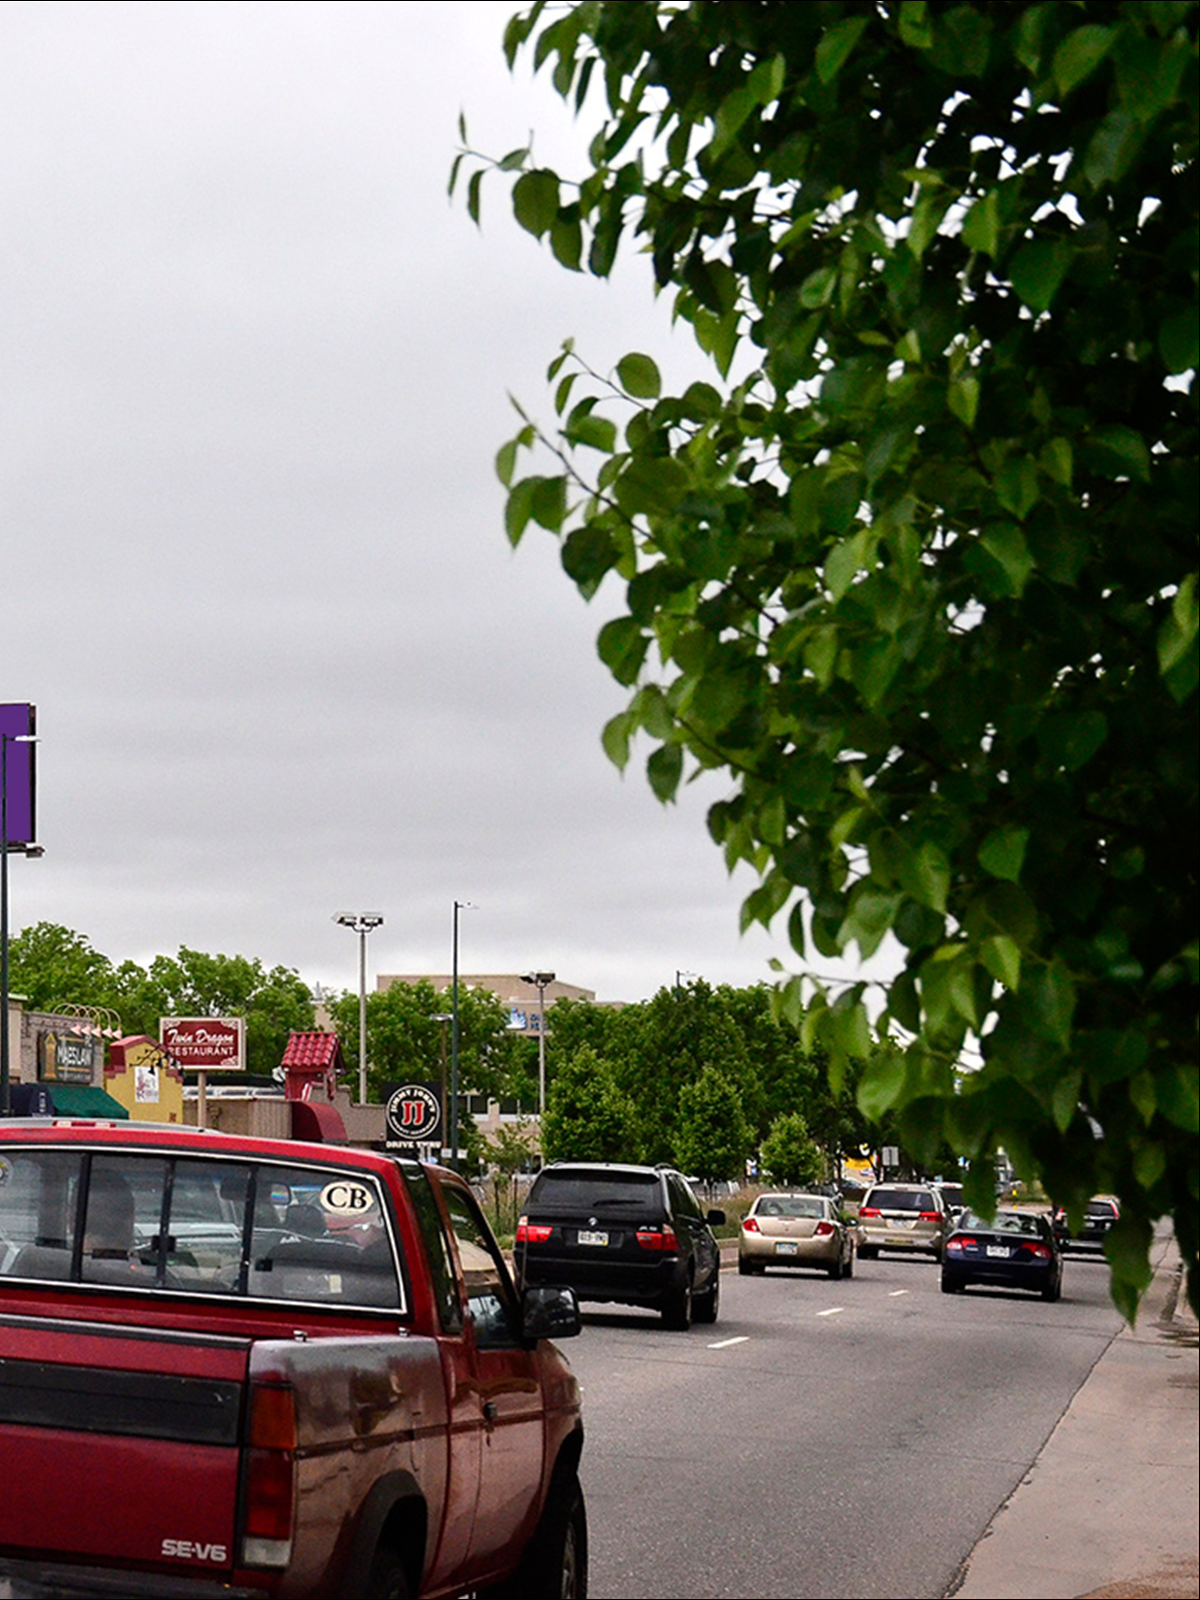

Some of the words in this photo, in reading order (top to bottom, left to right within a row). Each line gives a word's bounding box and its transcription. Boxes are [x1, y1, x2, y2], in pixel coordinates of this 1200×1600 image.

[167, 1029, 193, 1044] Twin
[195, 1029, 234, 1047] Dragon
[167, 1045, 234, 1056] RESTAURANT
[390, 1089, 411, 1113] JIMMY
[401, 1101, 425, 1125] JJ
[386, 1141, 414, 1149] DRIVE
[327, 1186, 367, 1209] CB
